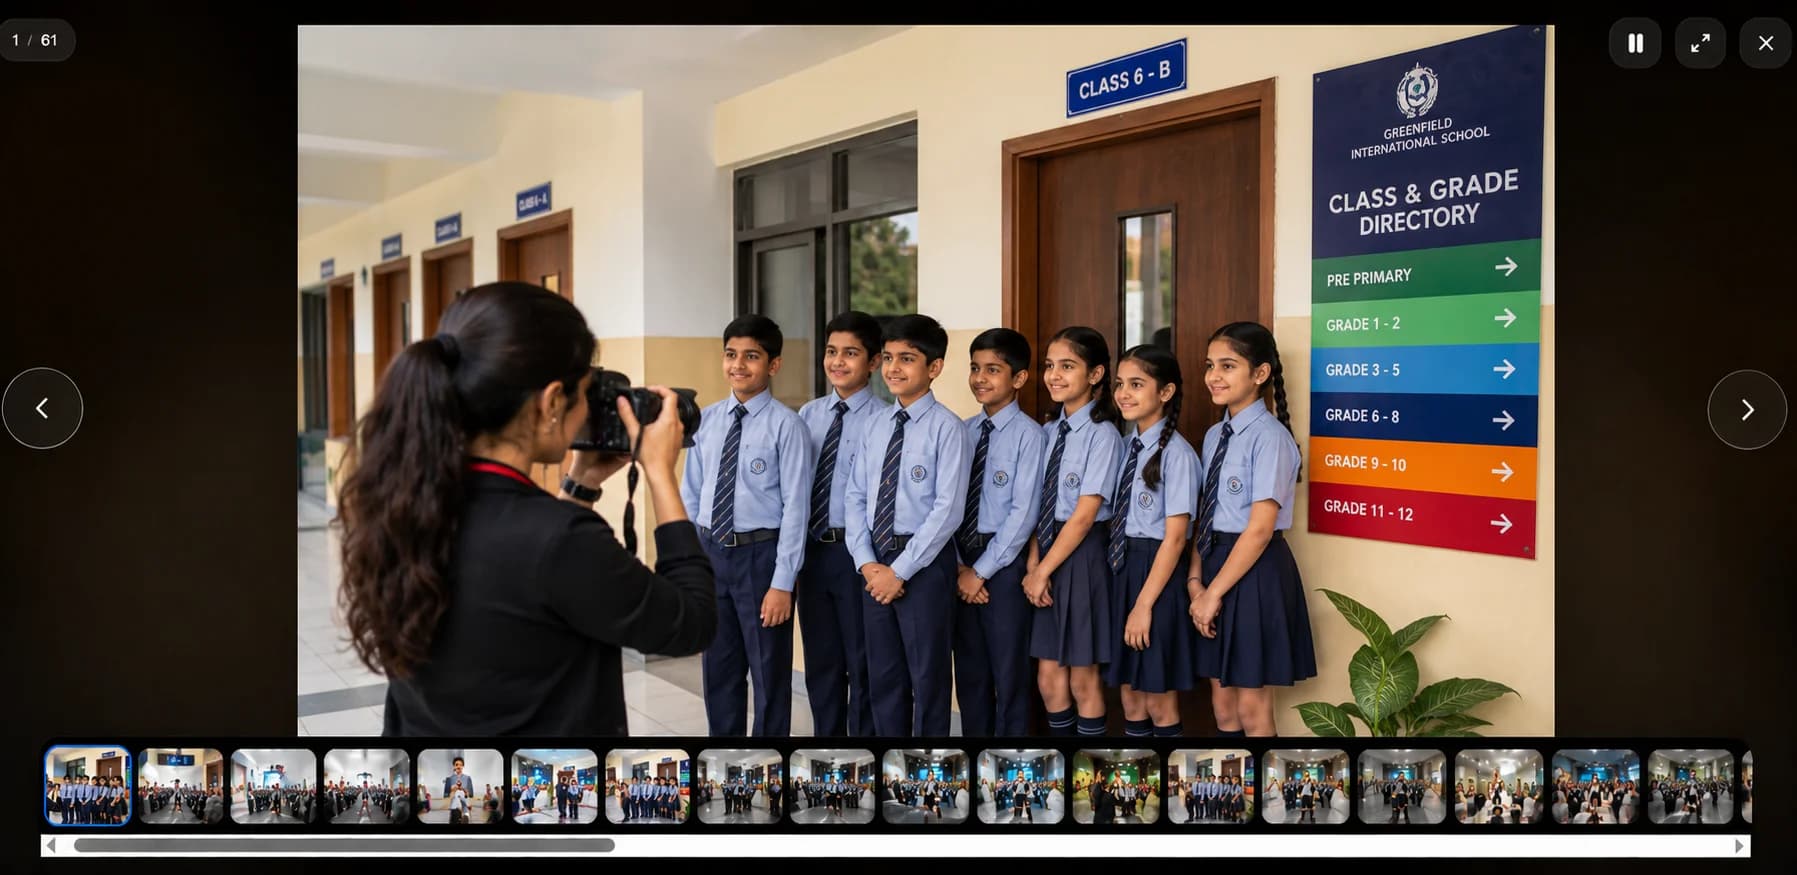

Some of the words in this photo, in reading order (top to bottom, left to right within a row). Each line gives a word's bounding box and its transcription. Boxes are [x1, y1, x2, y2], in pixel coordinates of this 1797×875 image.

[1079, 71, 1129, 99] CLASS
[1134, 67, 1144, 85] 6
[1159, 60, 1171, 79] B
[1384, 117, 1452, 140] GREENFIELD
[1351, 135, 1437, 160] INTERNATIONAL
[1441, 126, 1490, 144] SCHOOL
[1329, 186, 1397, 214] CLASS
[1405, 183, 1421, 204] &
[1430, 168, 1519, 200] GRADE
[1360, 202, 1480, 236] DIRECTORY
[1327, 273, 1350, 287] PRE
[1353, 268, 1412, 286] PRIMARY
[1326, 318, 1369, 332] GRADE
[1373, 317, 1379, 330] 1
[1392, 316, 1400, 330] 2
[1326, 363, 1368, 377] GRADE
[1372, 363, 1380, 376] 3
[1392, 363, 1400, 377] 5
[1325, 408, 1368, 422] GRADE
[1371, 409, 1380, 423] 6
[1391, 410, 1400, 424] 8
[1324, 454, 1367, 469] GRADE
[1371, 456, 1379, 470] 9
[1391, 458, 1407, 472] 10
[1324, 499, 1367, 516] GRADE
[1371, 504, 1384, 518] 11
[1398, 507, 1413, 521] 12
